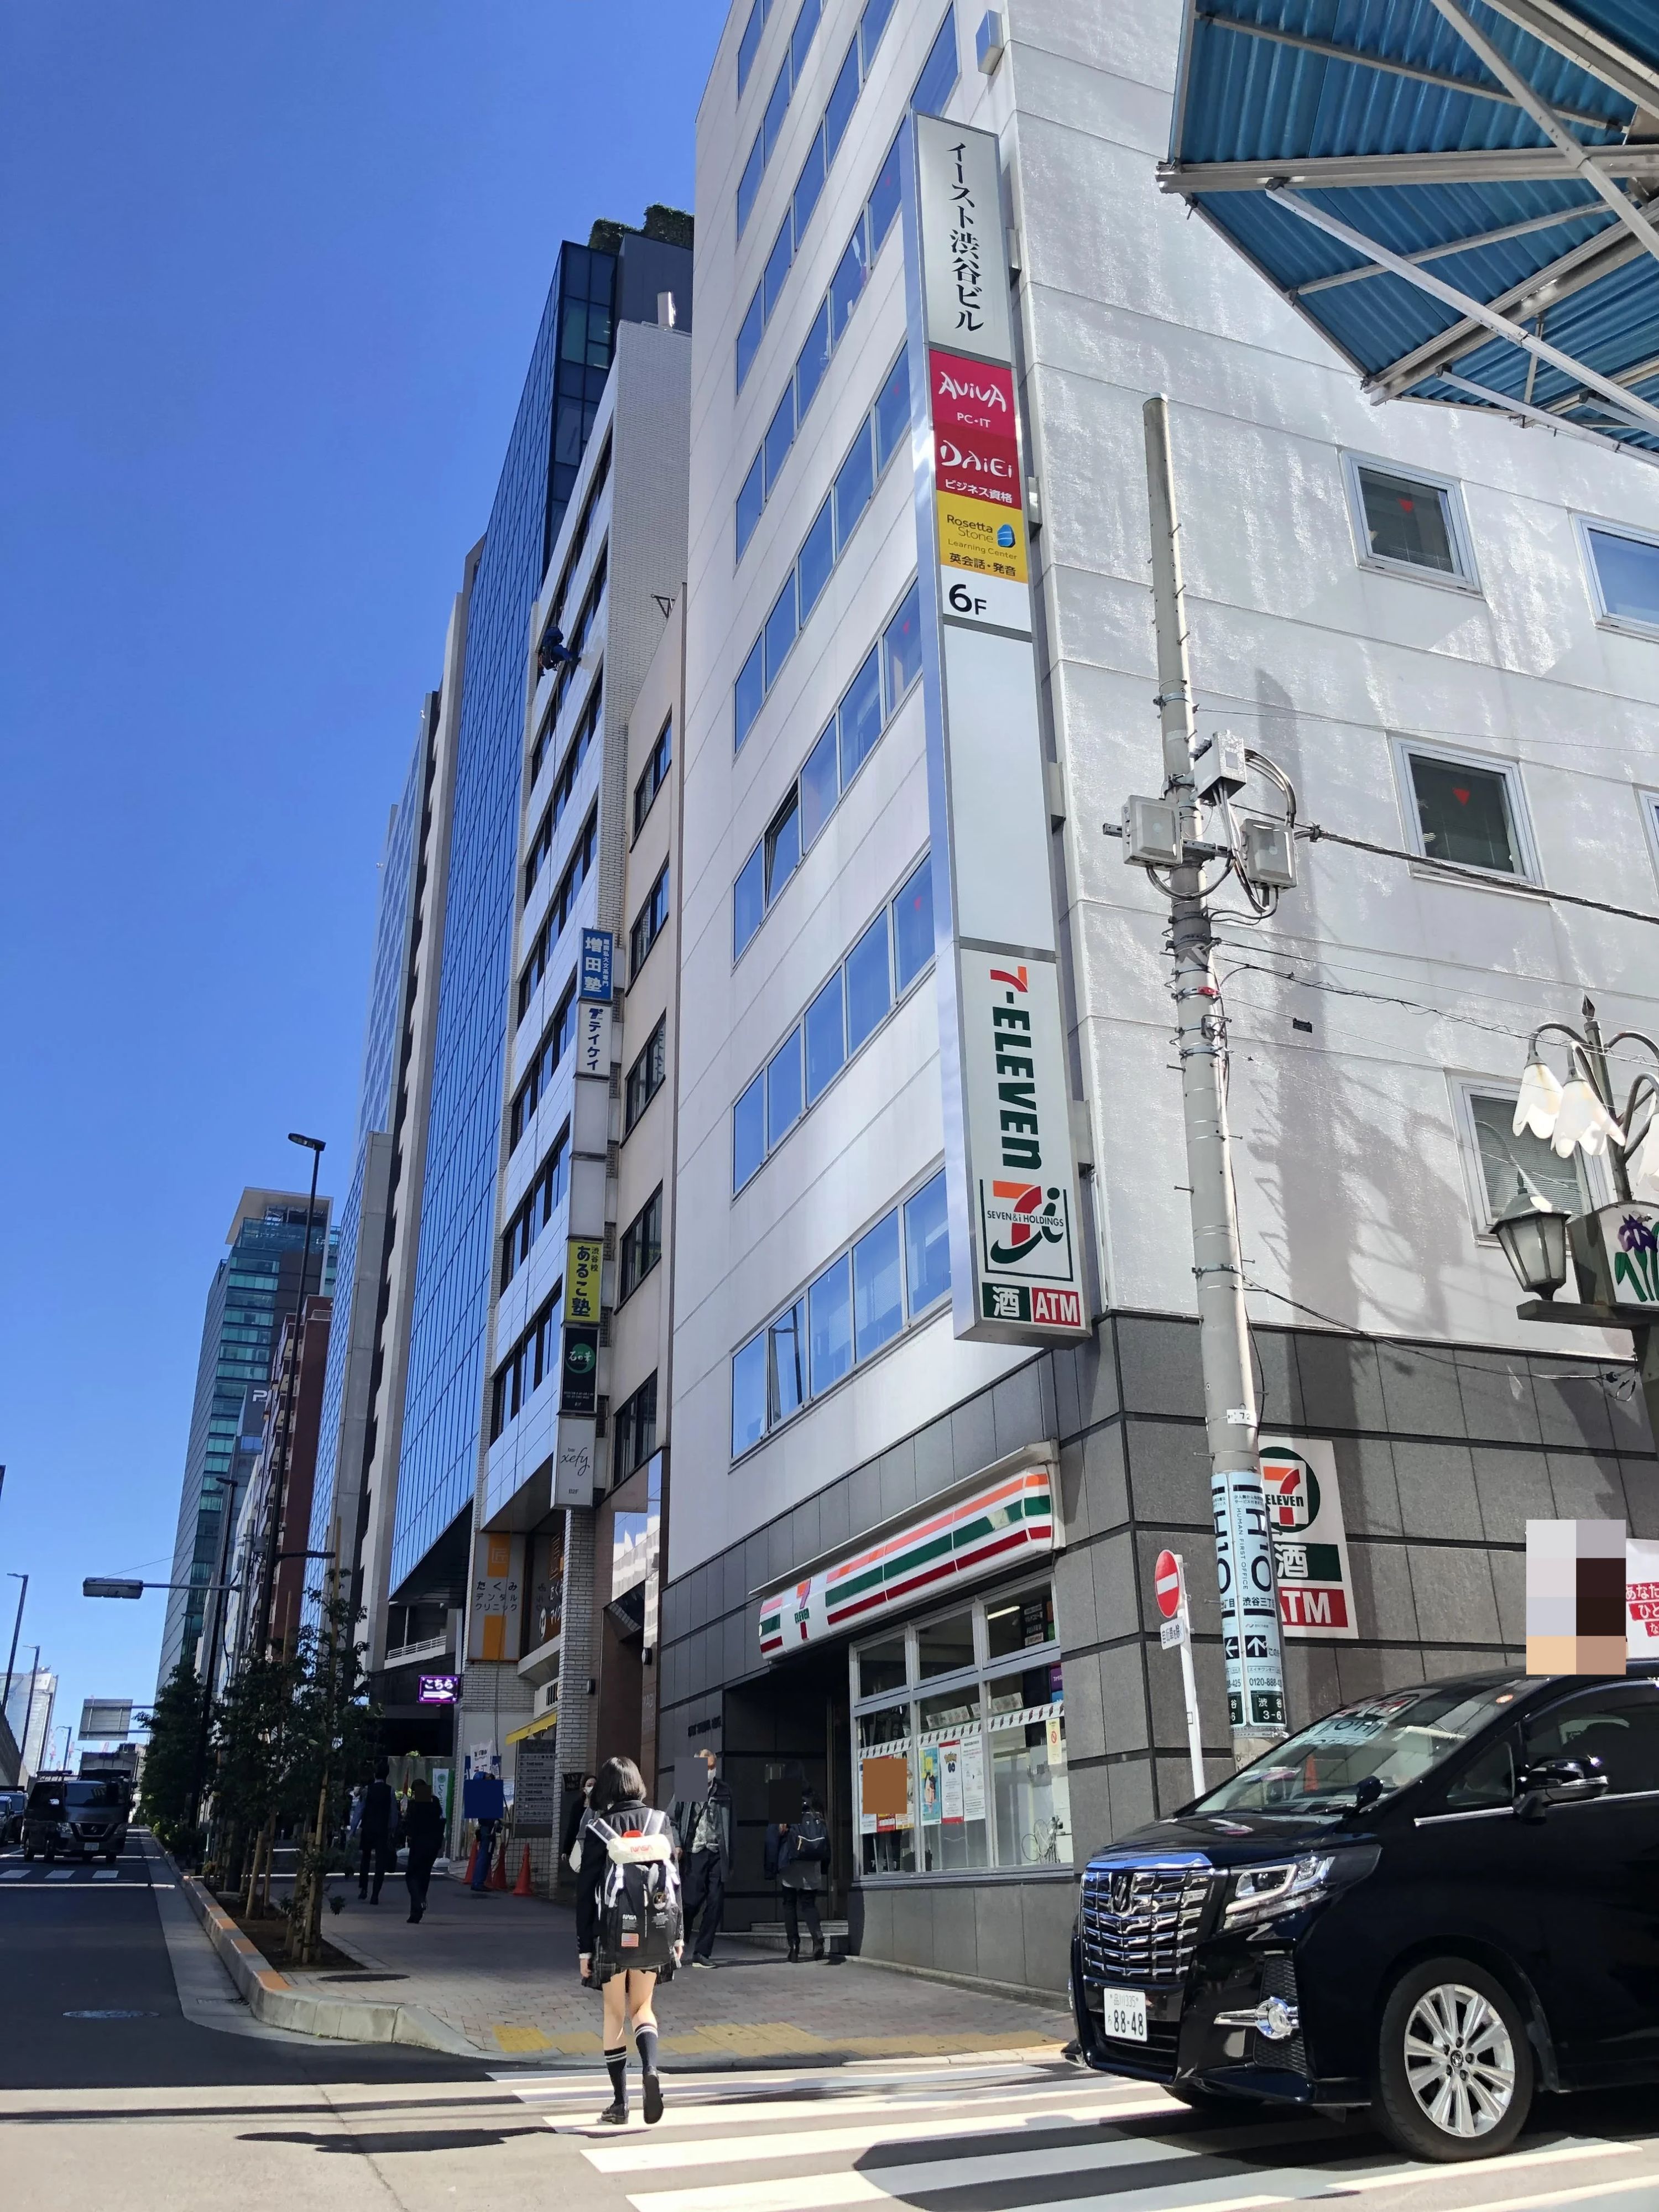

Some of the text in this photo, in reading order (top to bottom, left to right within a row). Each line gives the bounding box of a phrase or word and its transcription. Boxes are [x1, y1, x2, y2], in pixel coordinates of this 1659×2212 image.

[947, 143, 984, 332] イースト渋谷ビル
[945, 478, 1013, 503] ビジネス資格
[947, 514, 993, 534] Rosetta
[958, 526, 994, 543] Stone
[948, 539, 1018, 560] Learning Center
[949, 583, 987, 615] 6F
[1023, 1215, 1064, 1227] HOLDINGS
[992, 1286, 1020, 1317] 酒
[1035, 1291, 1078, 1323] ATM
[1274, 1543, 1308, 1578] 酒
[477, 1580, 517, 1591] たくみ
[1626, 1584, 1659, 1600] あなた
[476, 1593, 517, 1601] デンタル
[475, 1603, 517, 1611] クリニック
[1638, 1603, 1659, 1619] ひと
[425, 1679, 453, 1690] こちら
[1263, 1710, 1282, 1720] 3-6
[630, 1845, 653, 1853] NASA
[1125, 1995, 1136, 2007] 335
[1114, 2009, 1144, 2036] 88-48
